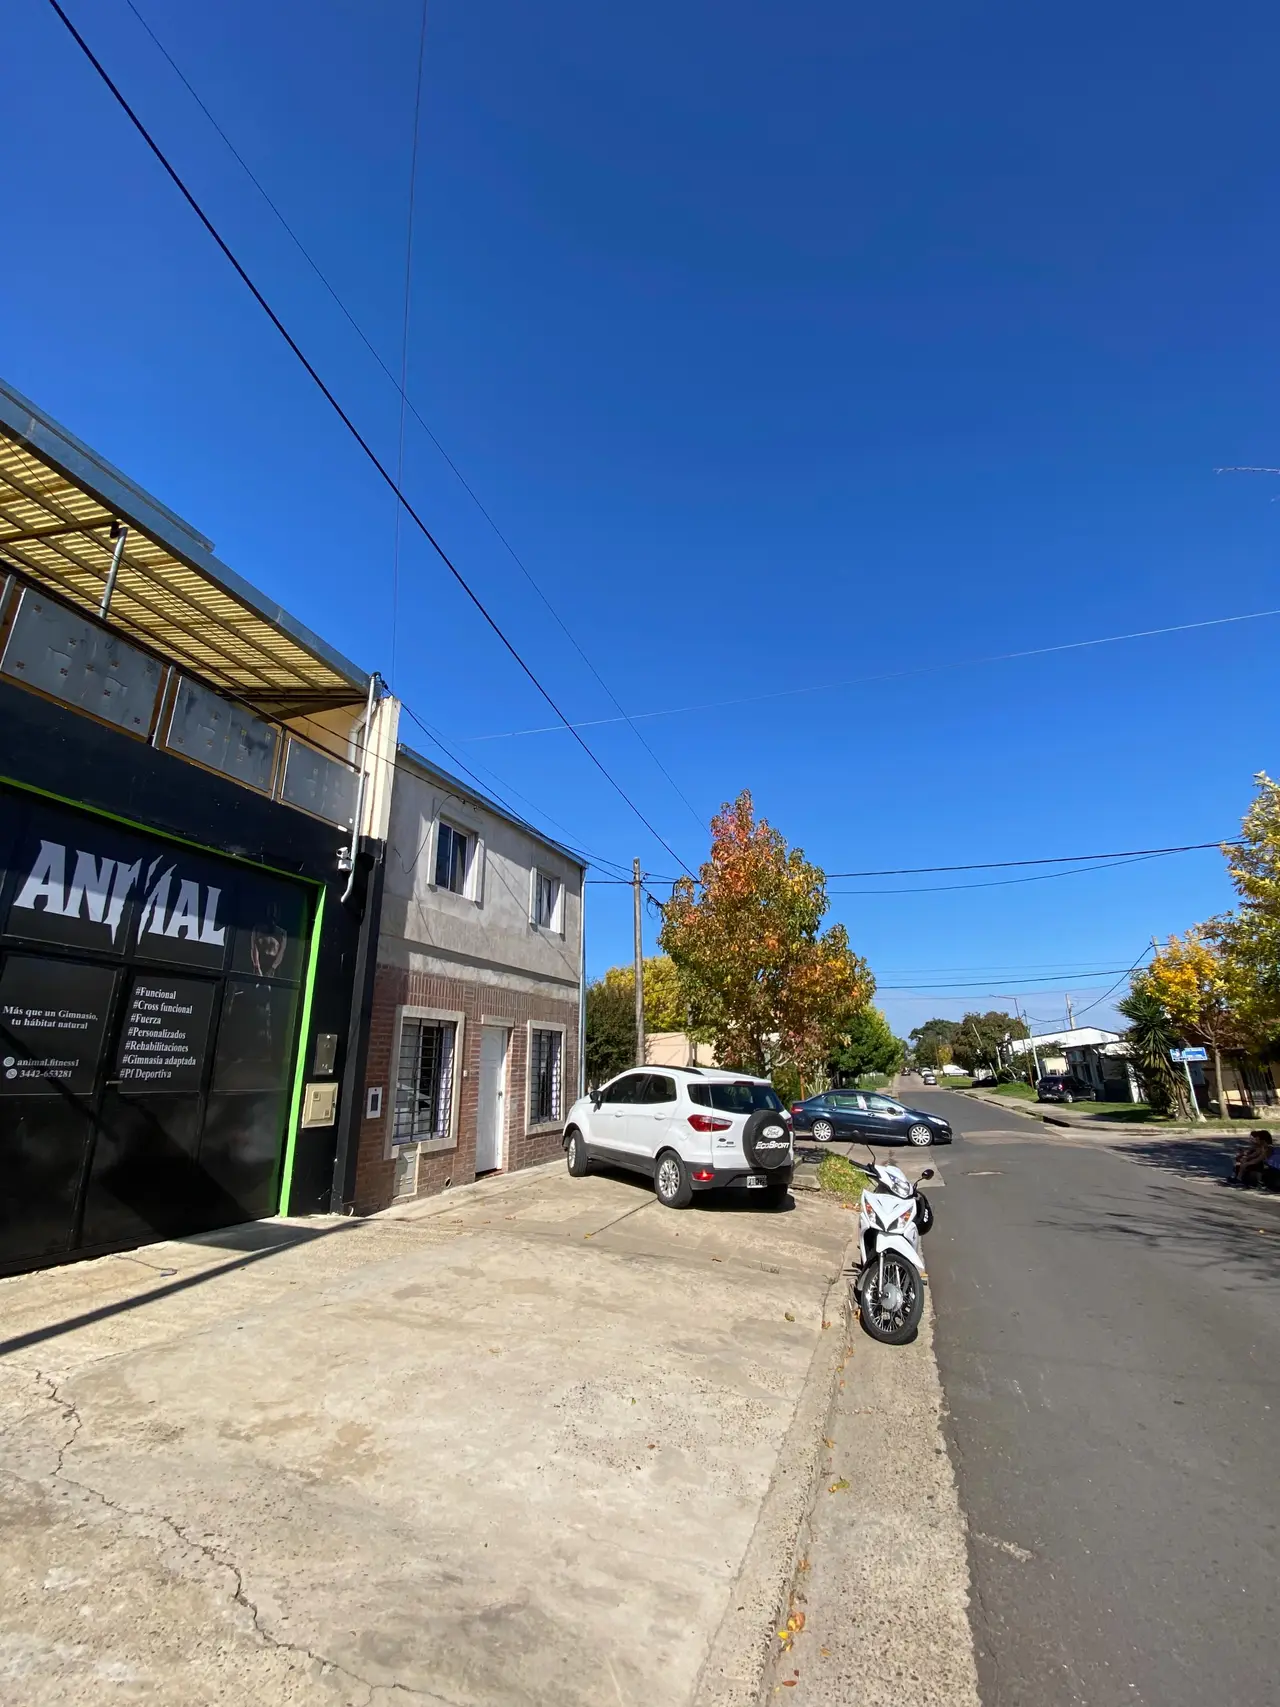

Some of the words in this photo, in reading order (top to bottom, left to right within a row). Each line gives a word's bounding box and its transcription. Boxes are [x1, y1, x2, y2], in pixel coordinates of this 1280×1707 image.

[13, 840, 226, 945] ANIMAL
[135, 986, 176, 999] #Funcional
[3, 1006, 23, 1015] Más
[25, 1009, 43, 1018] que
[58, 1010, 98, 1021] Gimnasio,
[133, 1000, 158, 1012] #Cross
[160, 1003, 193, 1014] funcional
[11, 1018, 21, 1026] tu
[24, 1018, 56, 1027] hábitat
[130, 1013, 162, 1024] #Fuerza
[127, 1026, 186, 1039] #Personalizados
[125, 1040, 189, 1052] #Rehabilitaciones
[122, 1054, 163, 1065] #Gimnasia
[164, 1056, 196, 1067] adaptada
[134, 1069, 172, 1081] Deportiva
